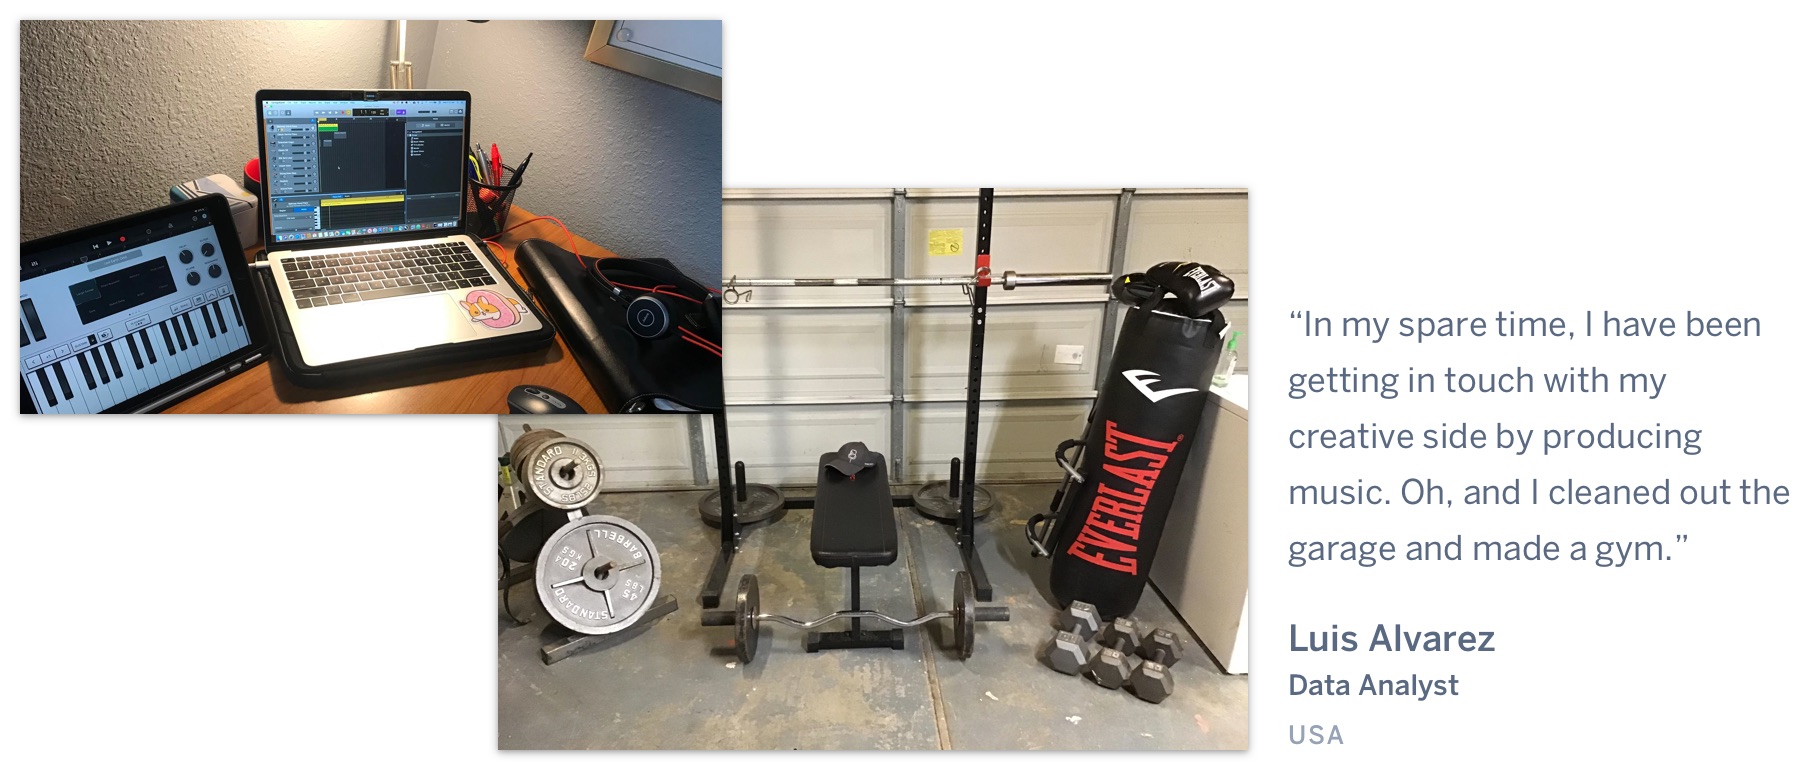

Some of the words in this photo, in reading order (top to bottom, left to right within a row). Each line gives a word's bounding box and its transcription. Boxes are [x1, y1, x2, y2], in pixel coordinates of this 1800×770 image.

[1183, 266, 1222, 298] EVERLAST
[534, 445, 563, 497] STANDARD
[561, 546, 584, 561] KGS
[594, 529, 642, 559] BARBELL
[622, 590, 639, 601] 45
[625, 579, 645, 593] LBS
[555, 588, 608, 620] STANDARD
